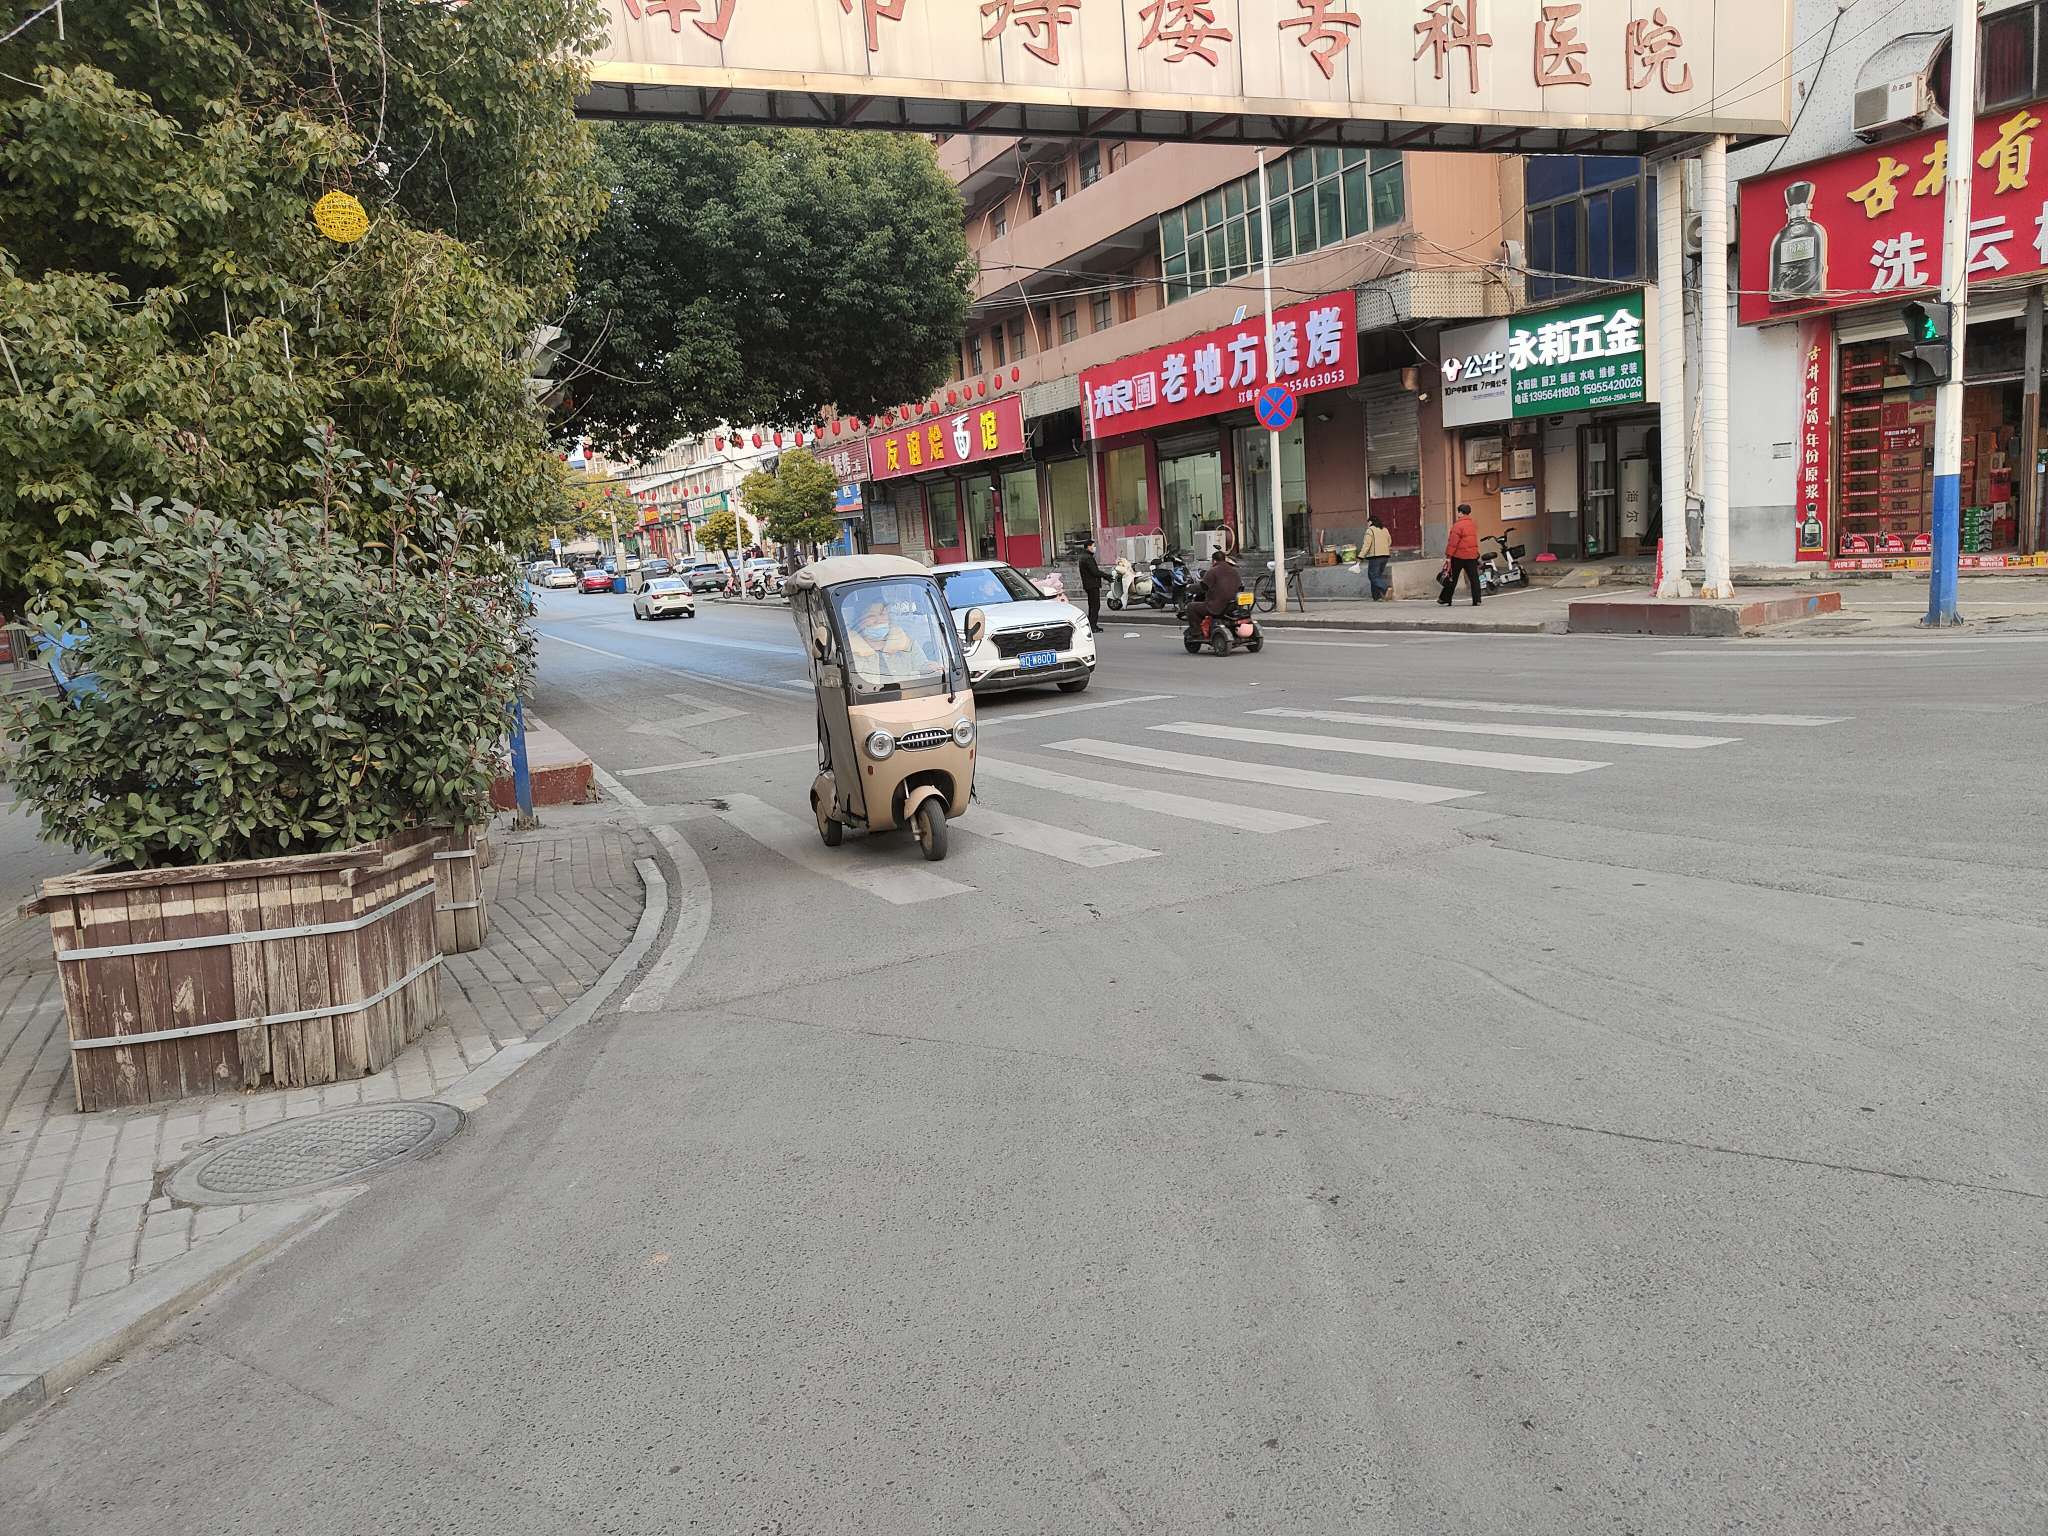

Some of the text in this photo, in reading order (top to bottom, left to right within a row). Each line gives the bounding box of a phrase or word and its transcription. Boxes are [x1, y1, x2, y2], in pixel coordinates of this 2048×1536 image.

[1160, 306, 1344, 404] 老地方烧烤
[1508, 308, 1643, 372] 永莉五金
[1463, 350, 1505, 379] 公牛
[1579, 369, 1595, 381] 水电
[1620, 362, 1638, 375] 安装
